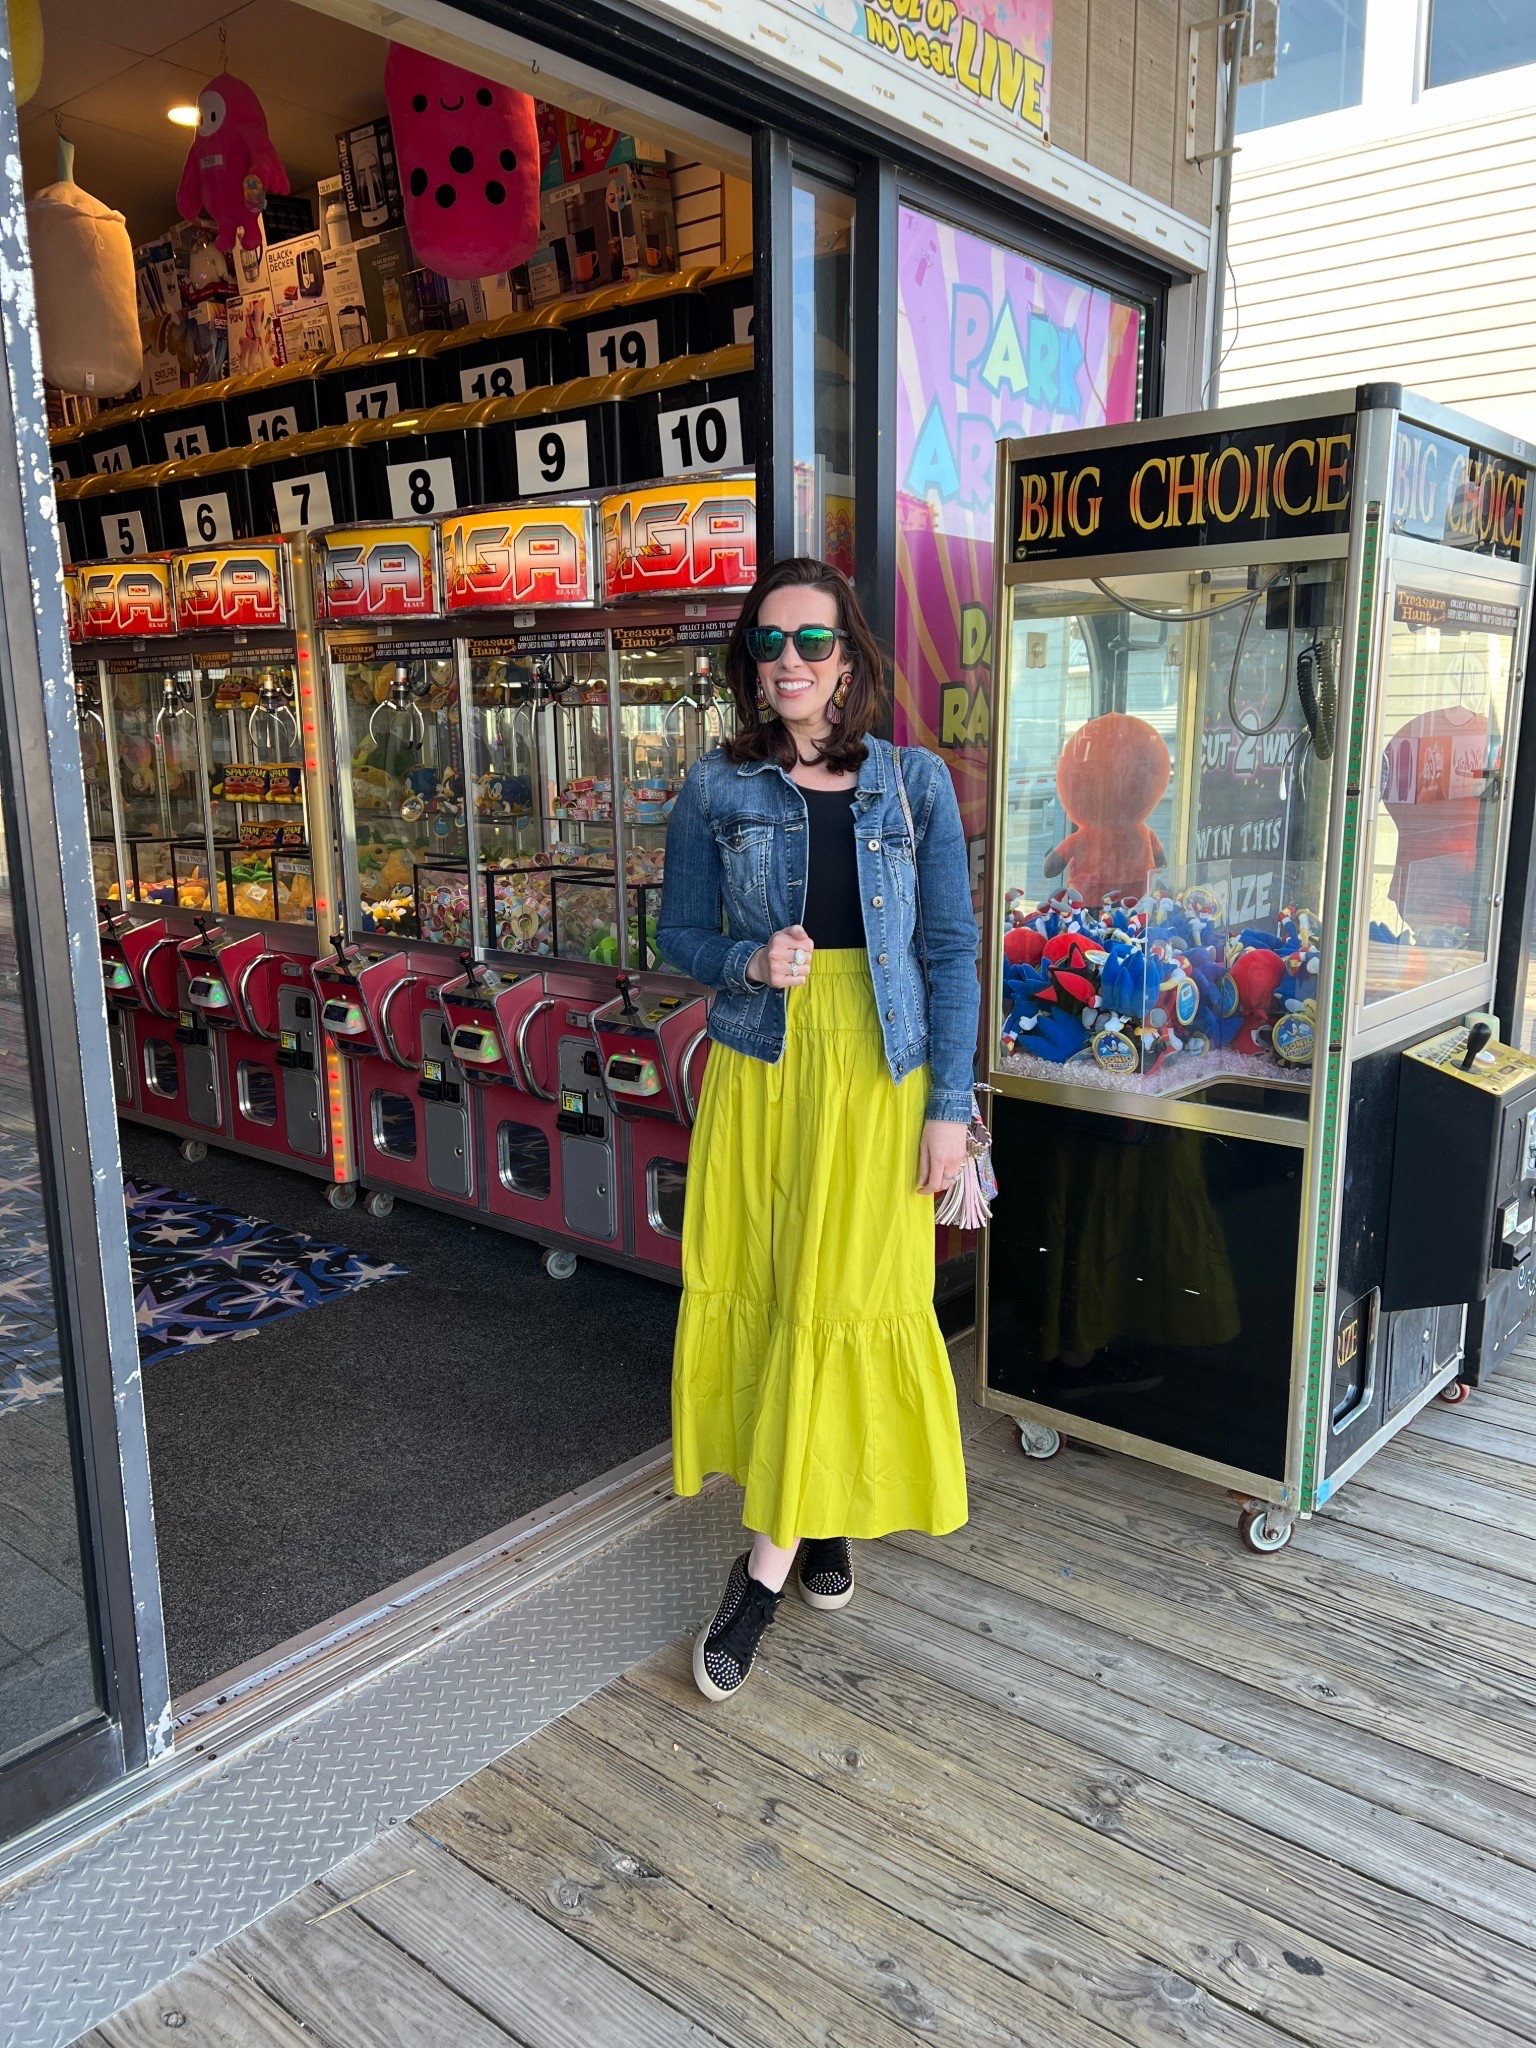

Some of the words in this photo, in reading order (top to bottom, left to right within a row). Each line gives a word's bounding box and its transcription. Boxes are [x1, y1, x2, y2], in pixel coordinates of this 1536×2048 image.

[864, 5, 900, 53] NO
[956, 15, 1045, 131] LIVE
[268, 249, 293, 262] BLACK+
[269, 258, 295, 273] DECKER
[214, 318, 227, 326] SAT
[600, 330, 647, 376] 19
[951, 283, 1085, 425] PARK
[471, 367, 515, 400] 18
[355, 390, 389, 419] 17
[257, 415, 289, 442] 16
[671, 407, 727, 468] 10
[173, 434, 201, 460] 15
[538, 432, 566, 482] 9
[903, 391, 1027, 516] AR
[407, 468, 435, 515] 8
[1018, 466, 1103, 542] BIG
[1129, 434, 1351, 530] CHOICE
[1393, 432, 1438, 524] BIG
[1447, 454, 1528, 549] CHOICE
[290, 483, 311, 526] 7
[196, 503, 217, 542] 6
[117, 518, 135, 555] 5
[693, 605, 698, 614] 9
[1398, 591, 1446, 611] Treasure
[522, 617, 527, 626] 8
[1402, 607, 1431, 621] Hunt
[467, 637, 514, 648] Treasure
[519, 634, 537, 642] COLLECT
[613, 627, 674, 639] Treasure
[620, 637, 657, 648] Hunt
[194, 652, 230, 662] Treasure
[333, 645, 374, 654] Treasure
[337, 653, 363, 663] Hunt
[472, 646, 502, 657] Hunt
[1235, 713, 1258, 770] 2
[1263, 732, 1295, 765] WIN
[225, 767, 249, 777] SPAM
[269, 769, 289, 778] SPAM
[240, 826, 259, 834] SPAM
[283, 825, 300, 834] SPAM
[1196, 823, 1234, 860] WIN
[1240, 818, 1282, 853] THIS
[1283, 1037, 1313, 1052] SONIC
[1102, 1056, 1131, 1064] SONIC
